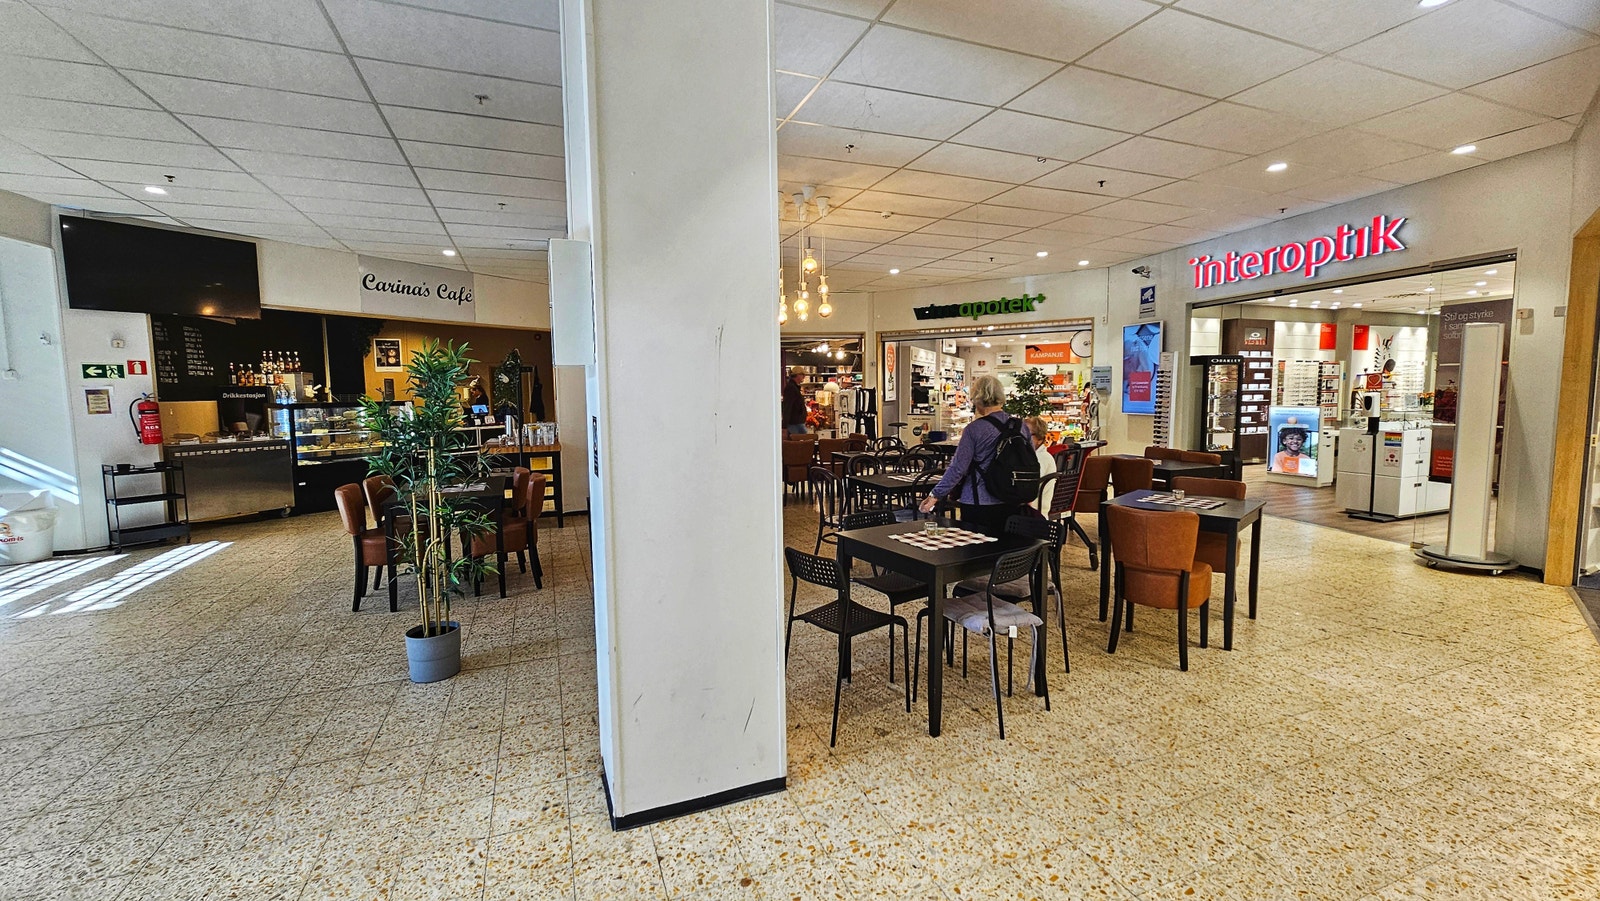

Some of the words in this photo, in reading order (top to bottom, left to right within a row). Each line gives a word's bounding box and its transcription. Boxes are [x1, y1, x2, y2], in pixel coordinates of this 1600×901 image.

[362, 273, 430, 298] Carina's
[436, 283, 473, 306] Café
[1469, 309, 1494, 319] styrke
